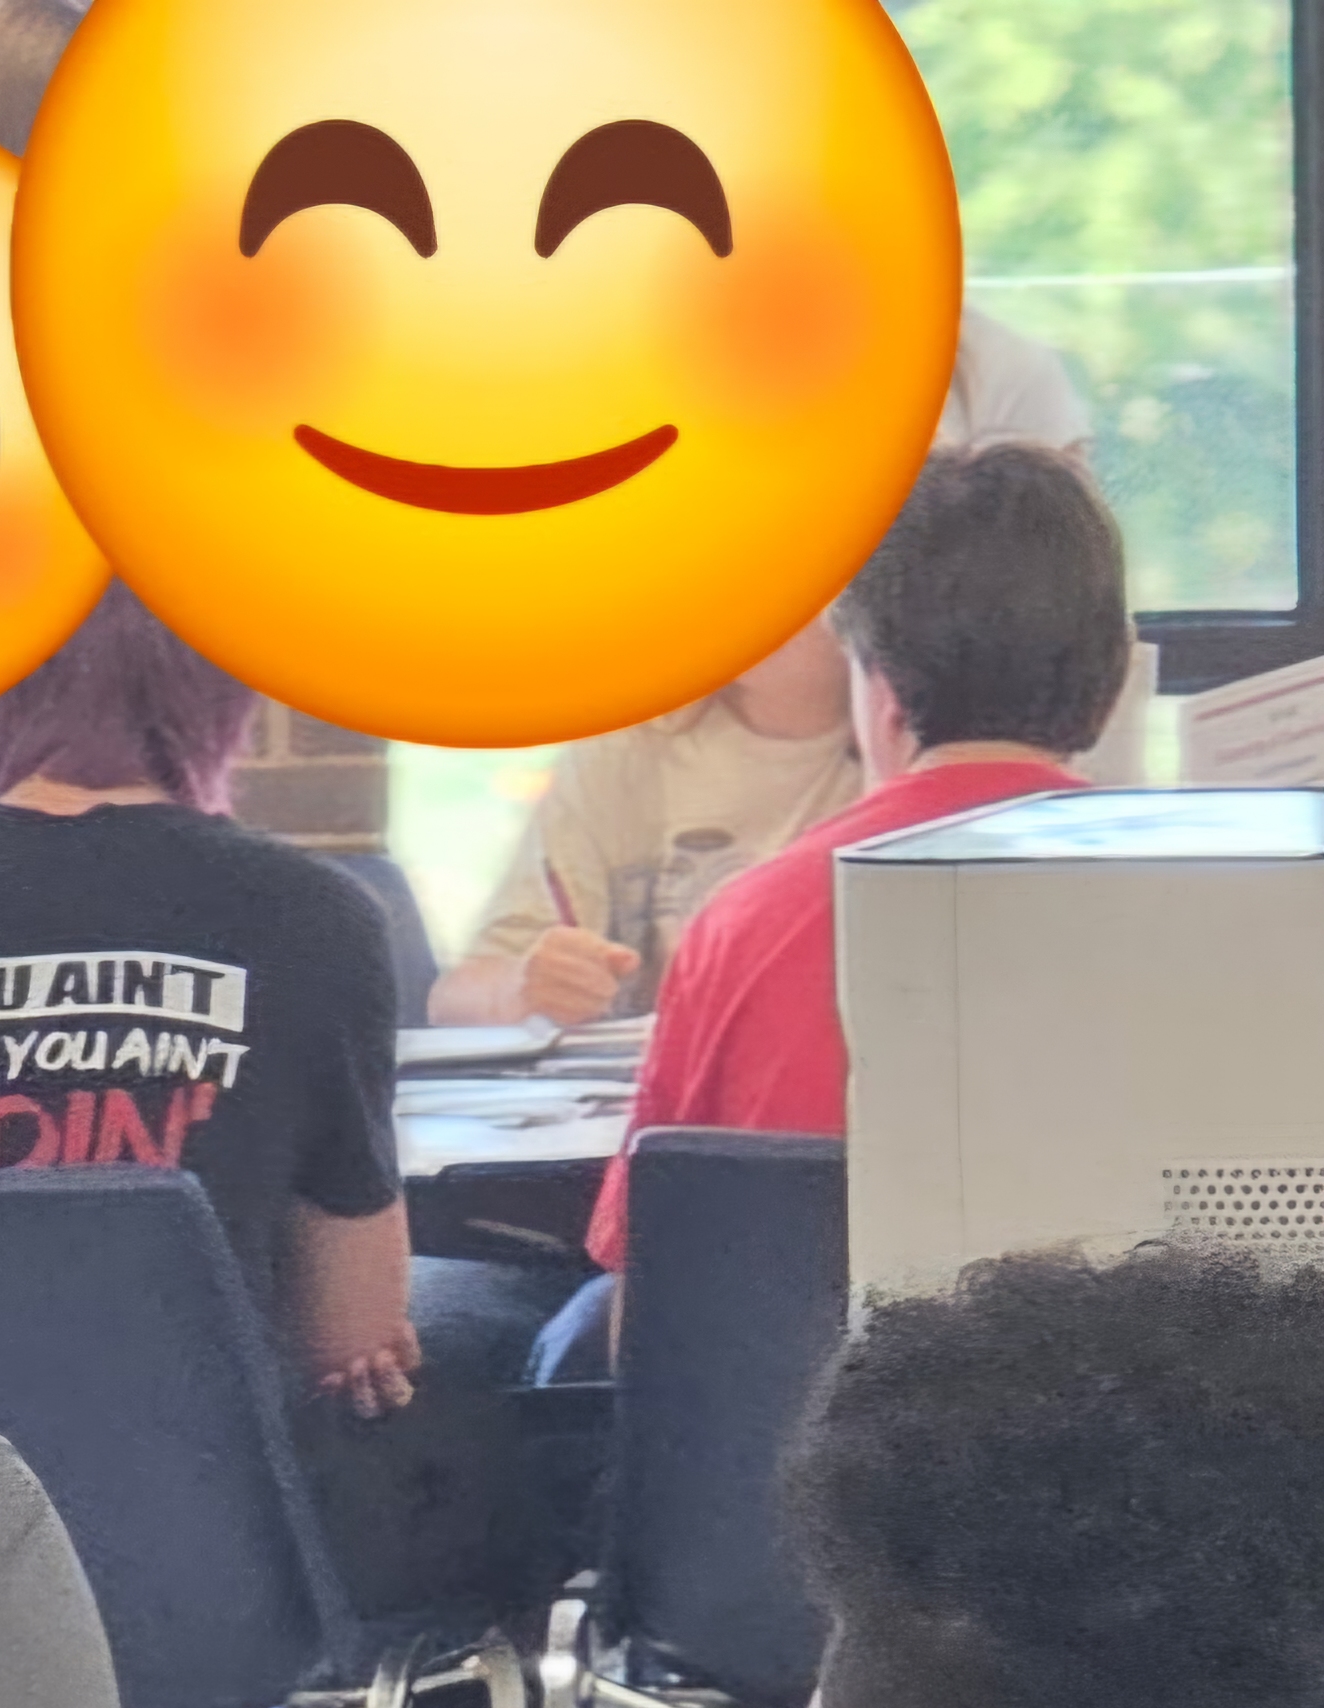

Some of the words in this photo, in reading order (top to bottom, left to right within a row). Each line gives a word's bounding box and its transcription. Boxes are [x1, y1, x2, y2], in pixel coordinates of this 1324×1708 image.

[44, 959, 226, 1016] AINT
[1, 1029, 109, 1081] YOU
[111, 1027, 252, 1089] AINT
